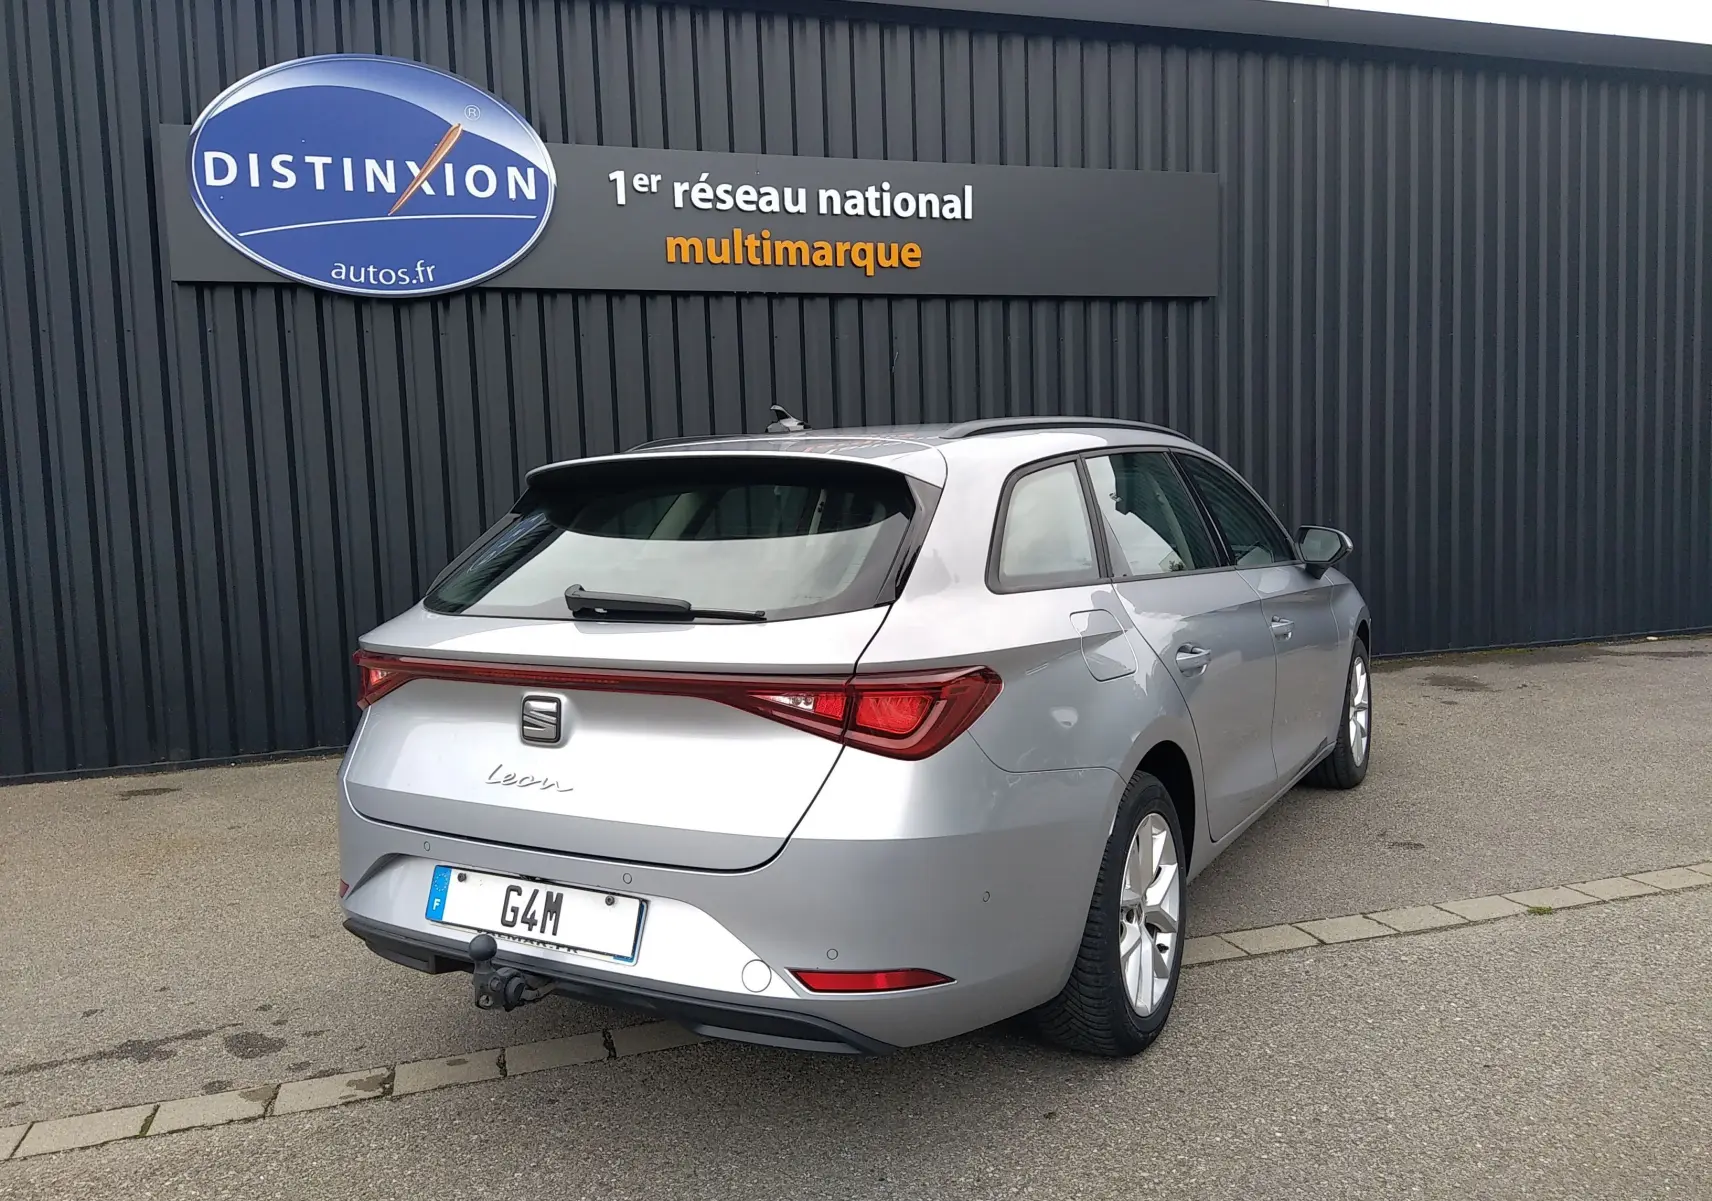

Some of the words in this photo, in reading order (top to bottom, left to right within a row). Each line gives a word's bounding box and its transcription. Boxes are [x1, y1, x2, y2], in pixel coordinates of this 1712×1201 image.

[203, 150, 537, 201] DISTINXION
[608, 169, 662, 206] 1er
[673, 173, 807, 214] réseau
[818, 181, 973, 220] national
[331, 260, 436, 285] autos.fr
[665, 228, 922, 277] multimarque
[485, 764, 574, 792] Leon
[432, 898, 441, 911] F
[501, 885, 564, 936] G4M
